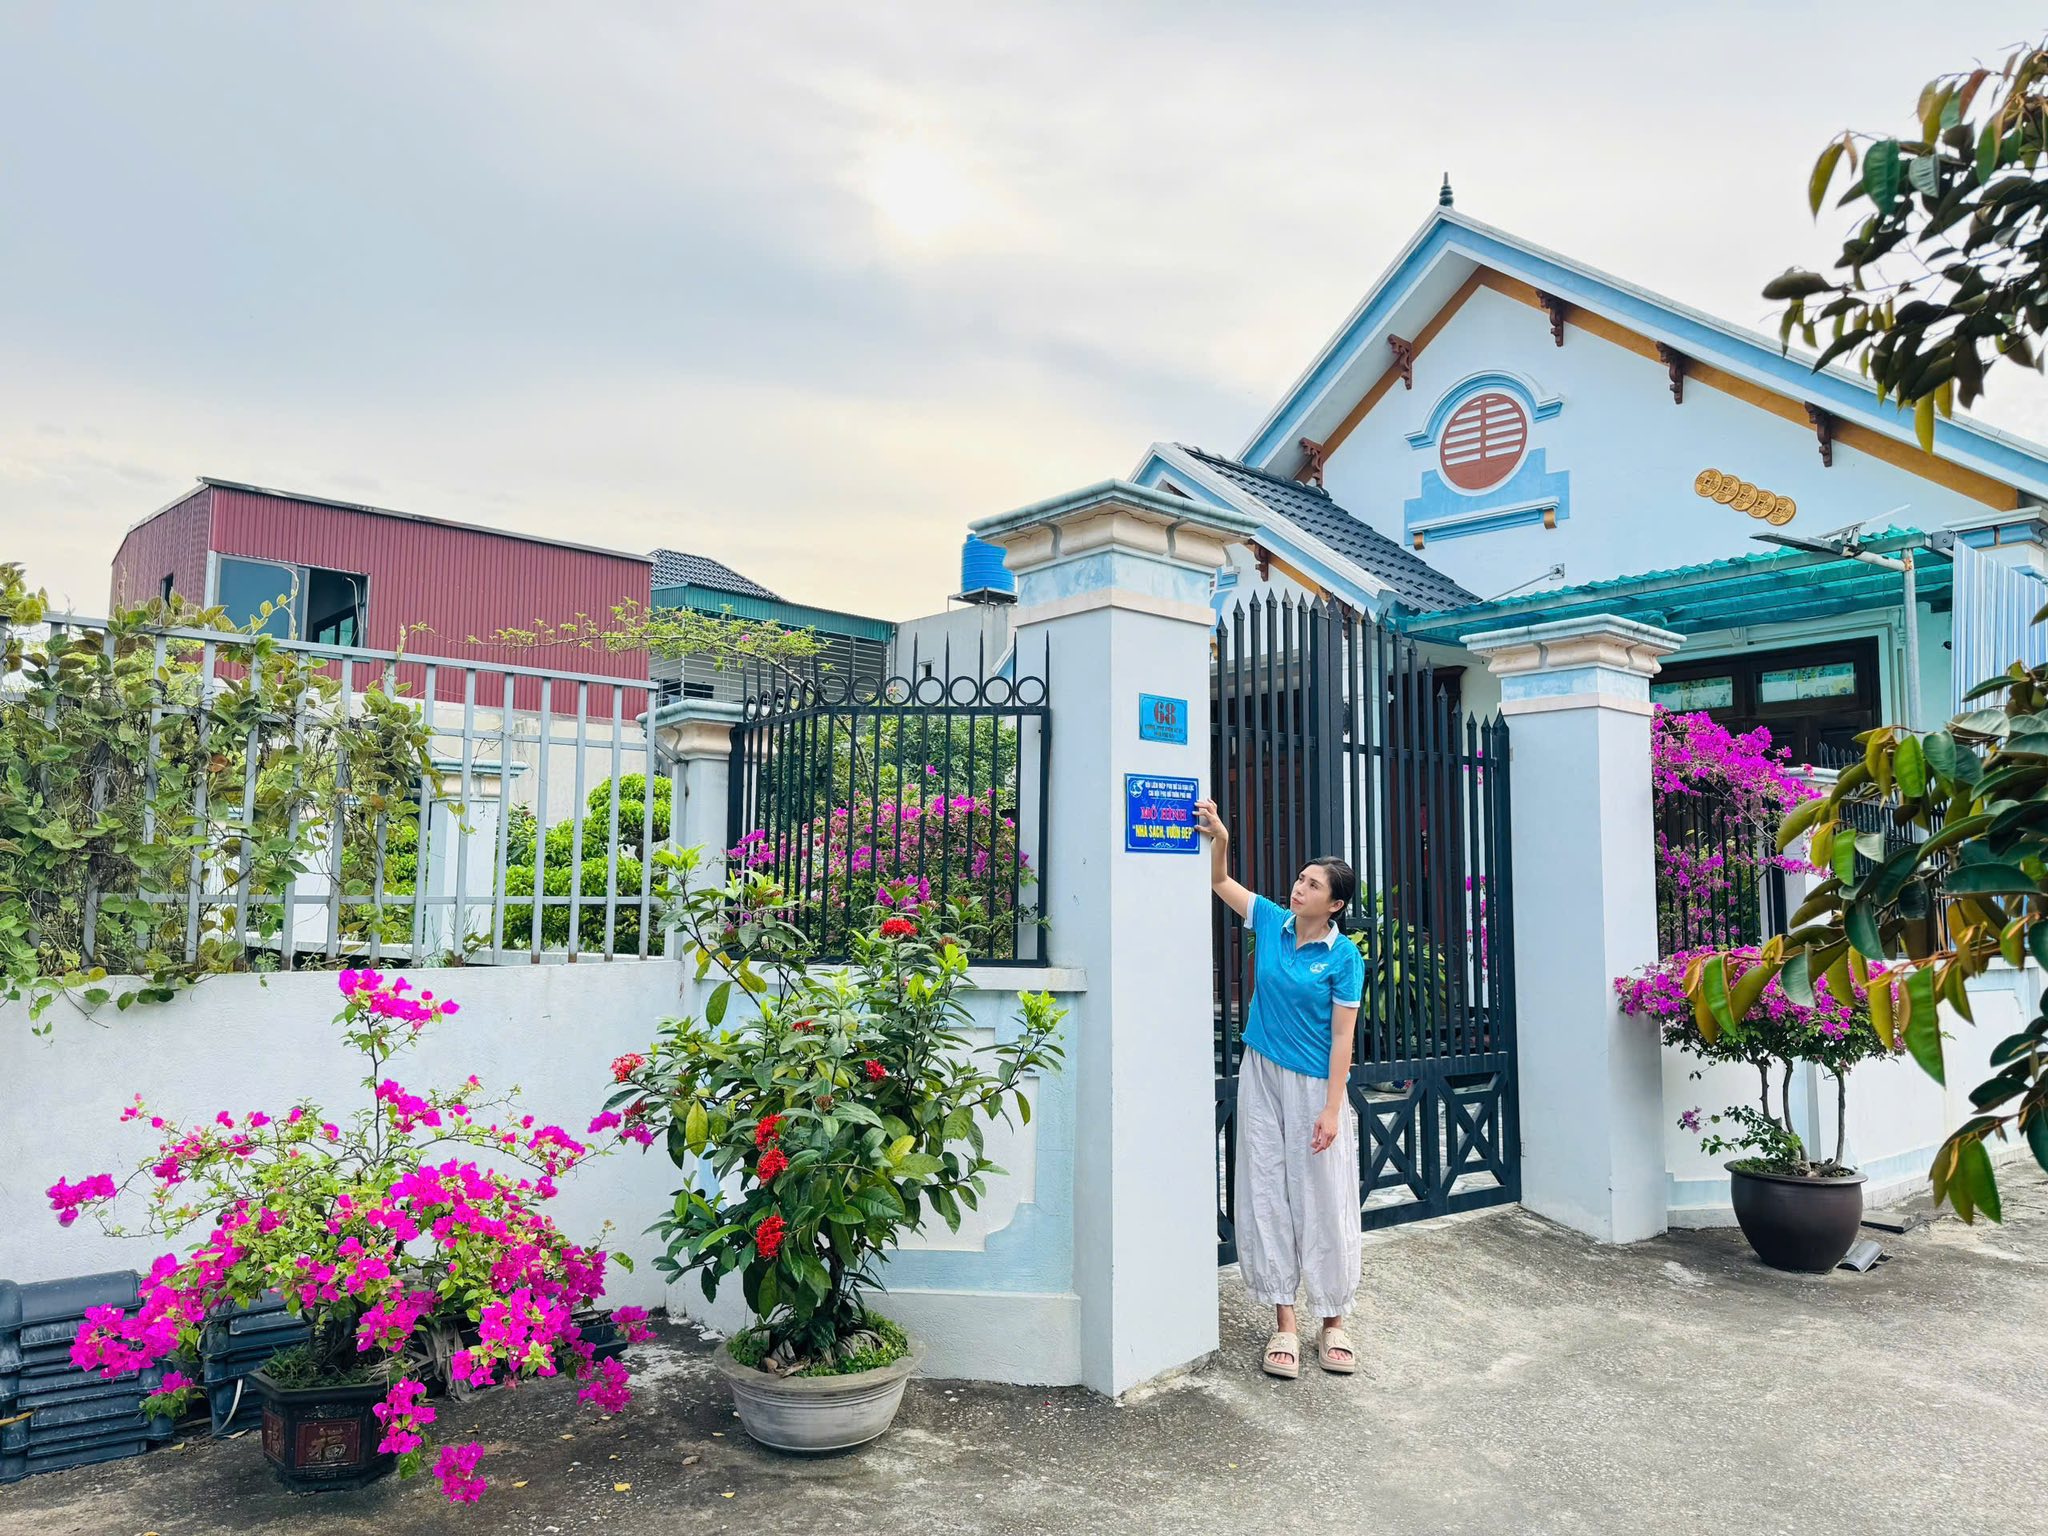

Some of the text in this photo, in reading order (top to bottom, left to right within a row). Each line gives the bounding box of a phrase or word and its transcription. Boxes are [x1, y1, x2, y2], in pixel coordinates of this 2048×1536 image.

[1154, 700, 1176, 725] 68
[1140, 804, 1187, 821] MÔ HÌNH
[1149, 825, 1166, 841] SẠCH,
